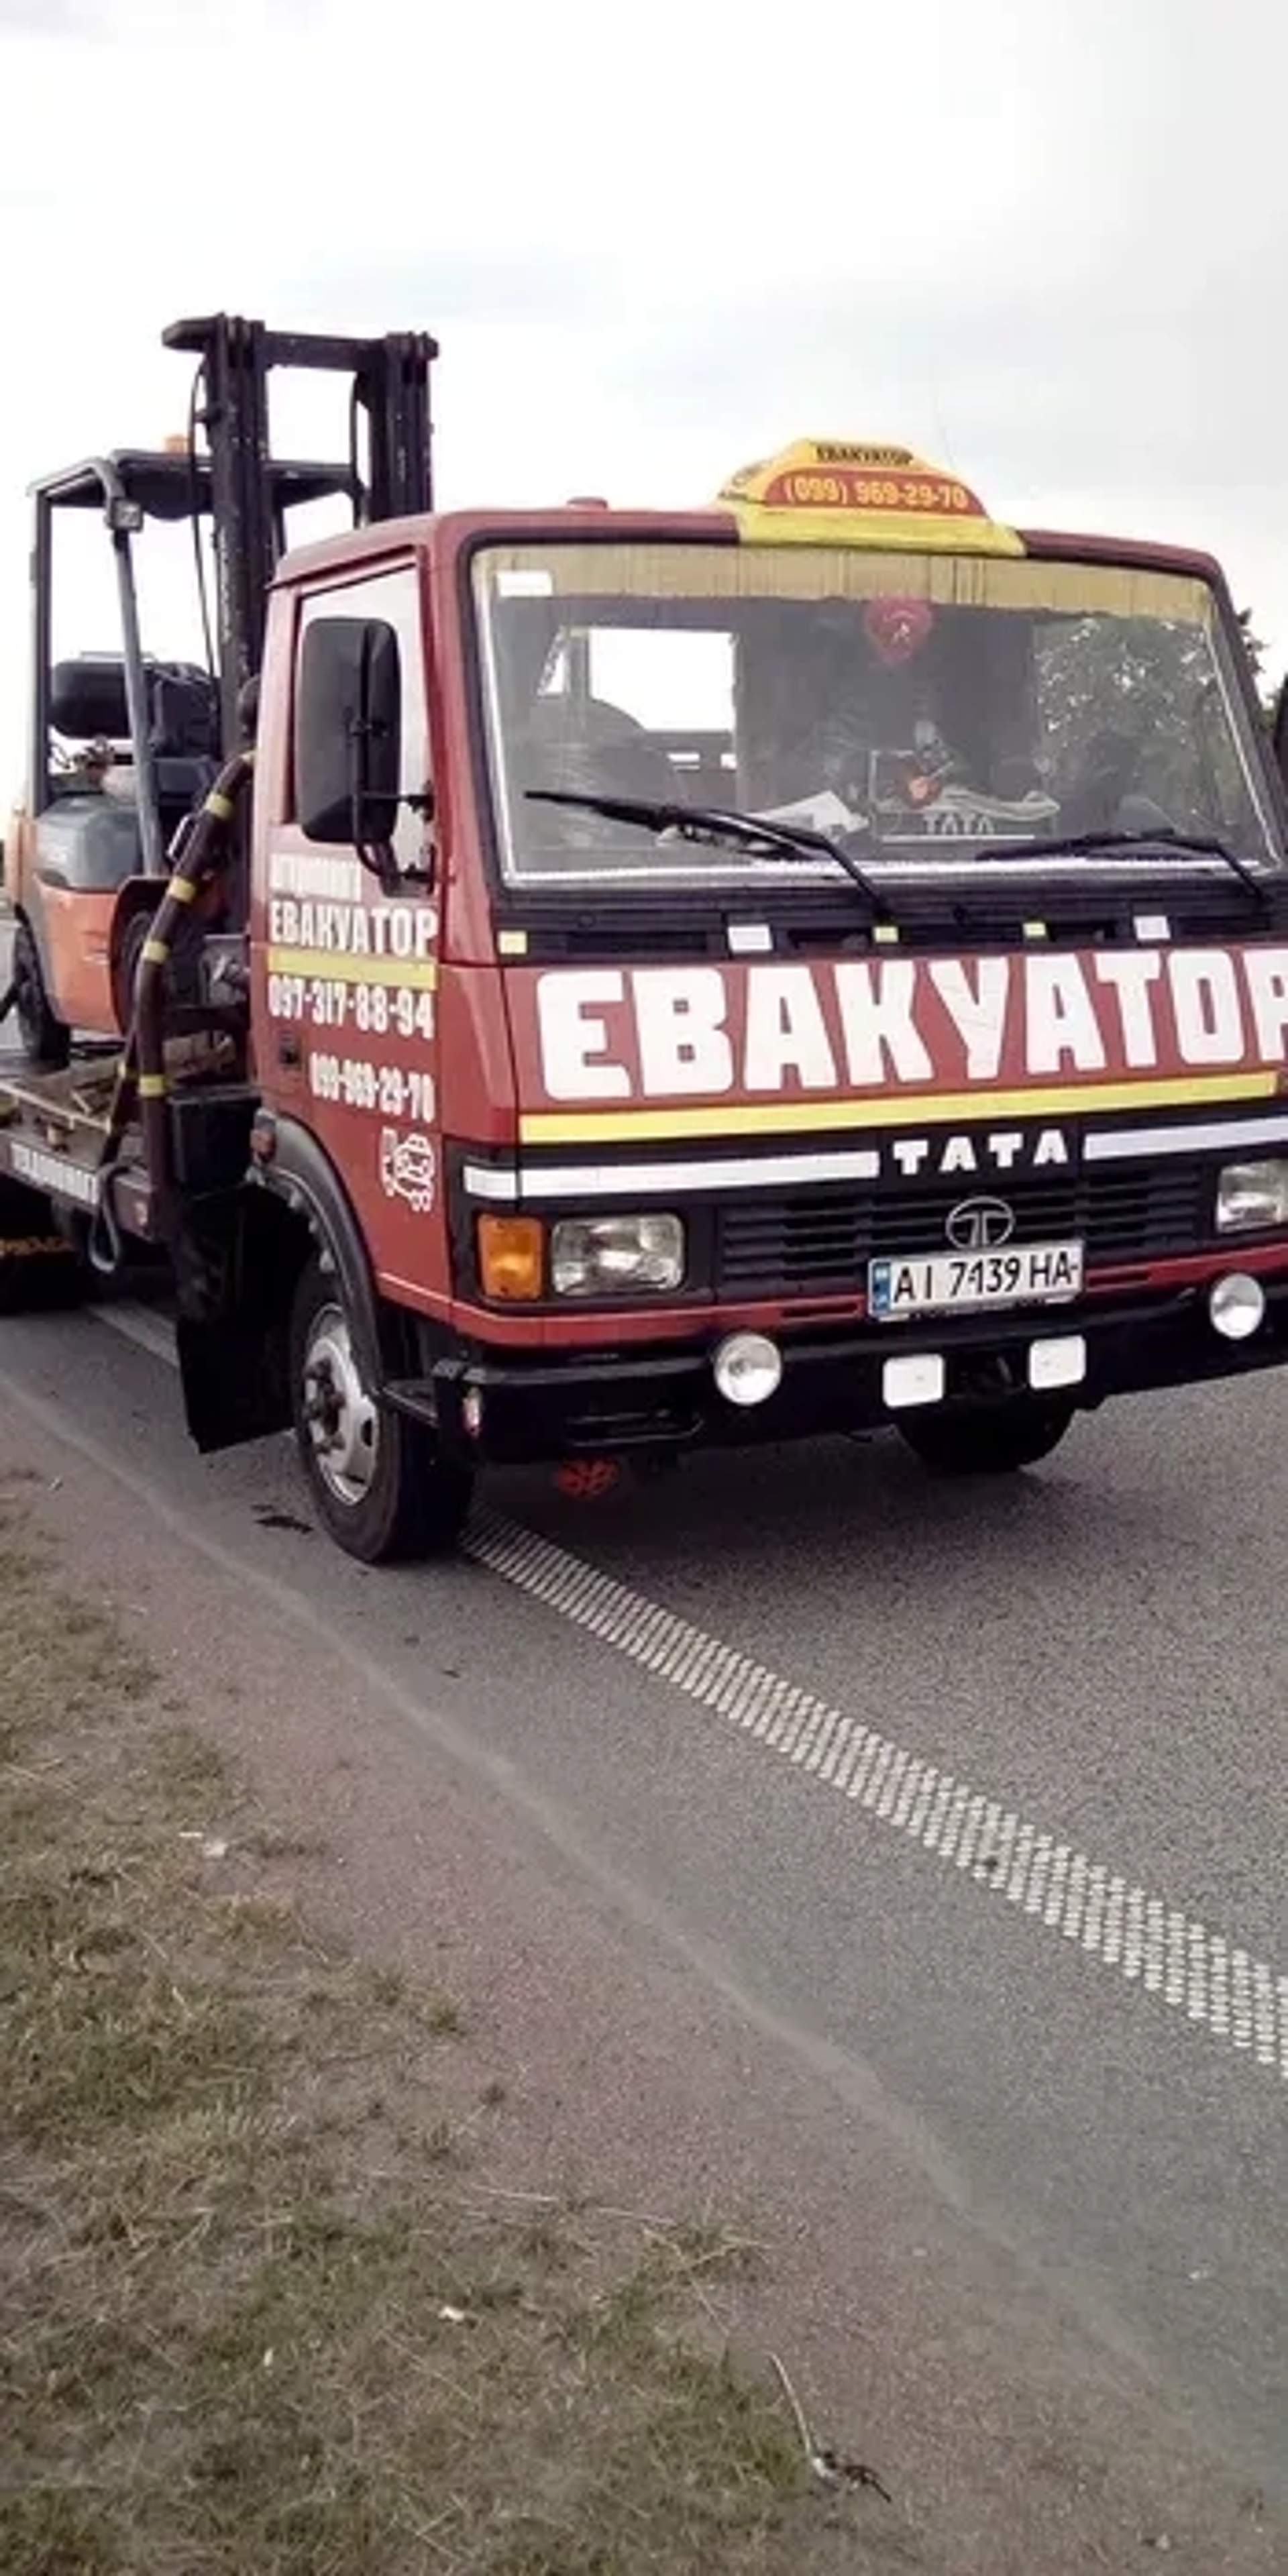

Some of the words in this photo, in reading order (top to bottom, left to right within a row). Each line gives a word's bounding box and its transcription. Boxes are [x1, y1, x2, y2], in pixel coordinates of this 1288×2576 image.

[784, 477, 848, 506] (099)
[855, 479, 969, 508] 969-29-70
[270, 900, 437, 957] ЕВАКУАТОР
[268, 974, 434, 1040] 097-317-88-94
[537, 949, 1288, 1100] ЕВАКУАТОР
[893, 1129, 1067, 1175] TATA
[948, 1257, 1022, 1297] 7139
